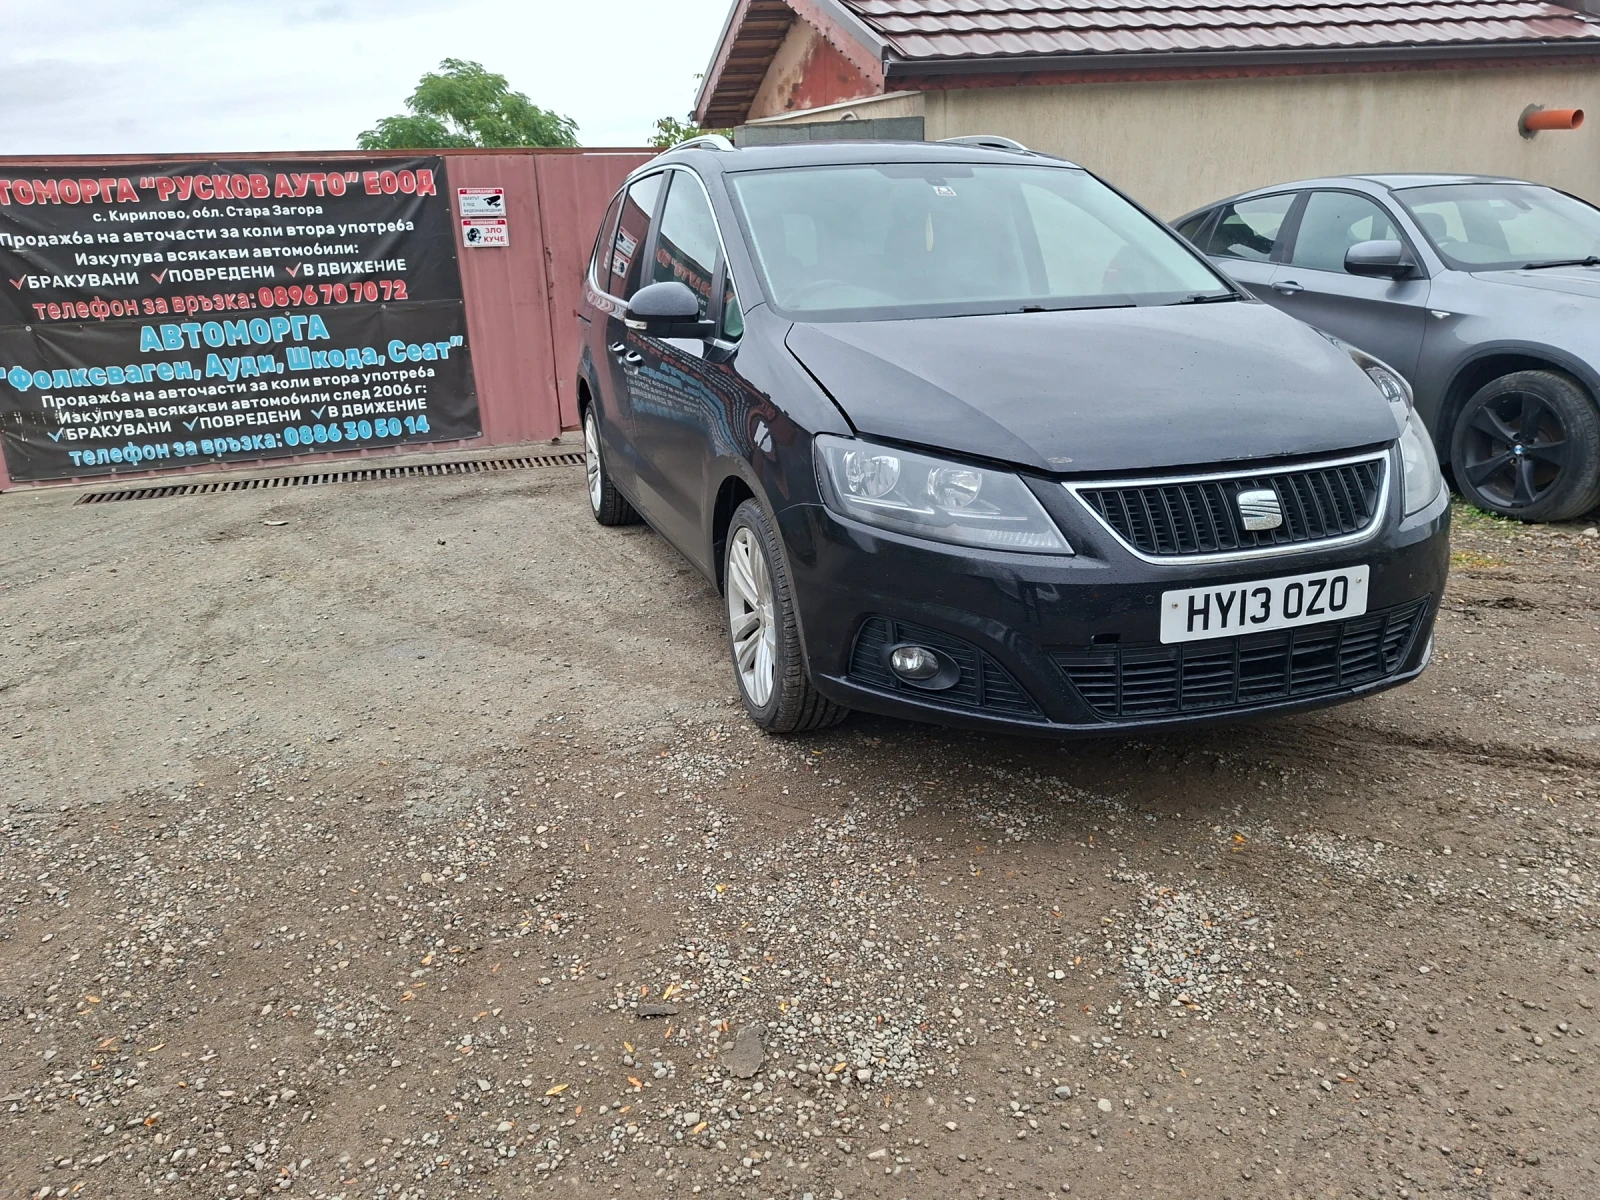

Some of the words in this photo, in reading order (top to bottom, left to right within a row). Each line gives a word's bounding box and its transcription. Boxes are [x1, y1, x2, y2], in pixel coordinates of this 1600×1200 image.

[362, 169, 436, 197] ЕООД
[92, 212, 107, 222] с.
[109, 208, 190, 224] Кирилово,
[192, 206, 224, 219] обл.
[226, 206, 270, 218] Стара
[272, 204, 323, 217] Загора
[0, 231, 94, 248] Продажба
[97, 232, 120, 244] на
[123, 228, 218, 243] авточасти
[220, 228, 240, 238] за
[242, 224, 284, 238] коли
[288, 224, 336, 238] втора
[338, 218, 415, 236] употреба
[75, 252, 164, 268] Изкупува
[166, 248, 250, 262] всякакви
[252, 242, 360, 258] автомобили:
[27, 272, 140, 290] БРАКУВАНИ
[168, 264, 276, 283] ПОВРЕДЕНИ
[303, 264, 315, 276] В
[318, 258, 408, 277] ДВИЖЕНИЕ
[32, 295, 140, 322] телефон
[142, 296, 169, 315] за
[172, 291, 257, 318] връзка:
[140, 314, 330, 352] АВТОМОРГА
[206, 353, 284, 382] Ауди,
[286, 345, 386, 371] Шкода,
[388, 335, 464, 364] Сеат"
[42, 391, 131, 410] Продажба
[134, 389, 154, 402] на
[158, 383, 247, 400] авточасти
[250, 380, 268, 392] за
[272, 376, 310, 390] коли
[313, 373, 360, 388] втора
[362, 366, 436, 386] употреба
[58, 407, 145, 424] Изкупува
[148, 400, 229, 417] всякакви
[231, 392, 330, 410] автомобили
[332, 388, 372, 402] след
[373, 384, 412, 398] 2006
[414, 384, 428, 395] г:
[66, 420, 172, 441] БРАКУВАНИ
[199, 408, 302, 430] ПОВРЕДЕНИ
[328, 405, 339, 418] В
[342, 398, 428, 419] ДВИЖЕНИЕ
[68, 441, 170, 466] телефон
[172, 438, 199, 458] за
[200, 431, 284, 457] връзка:
[1186, 586, 1272, 632] HY13
